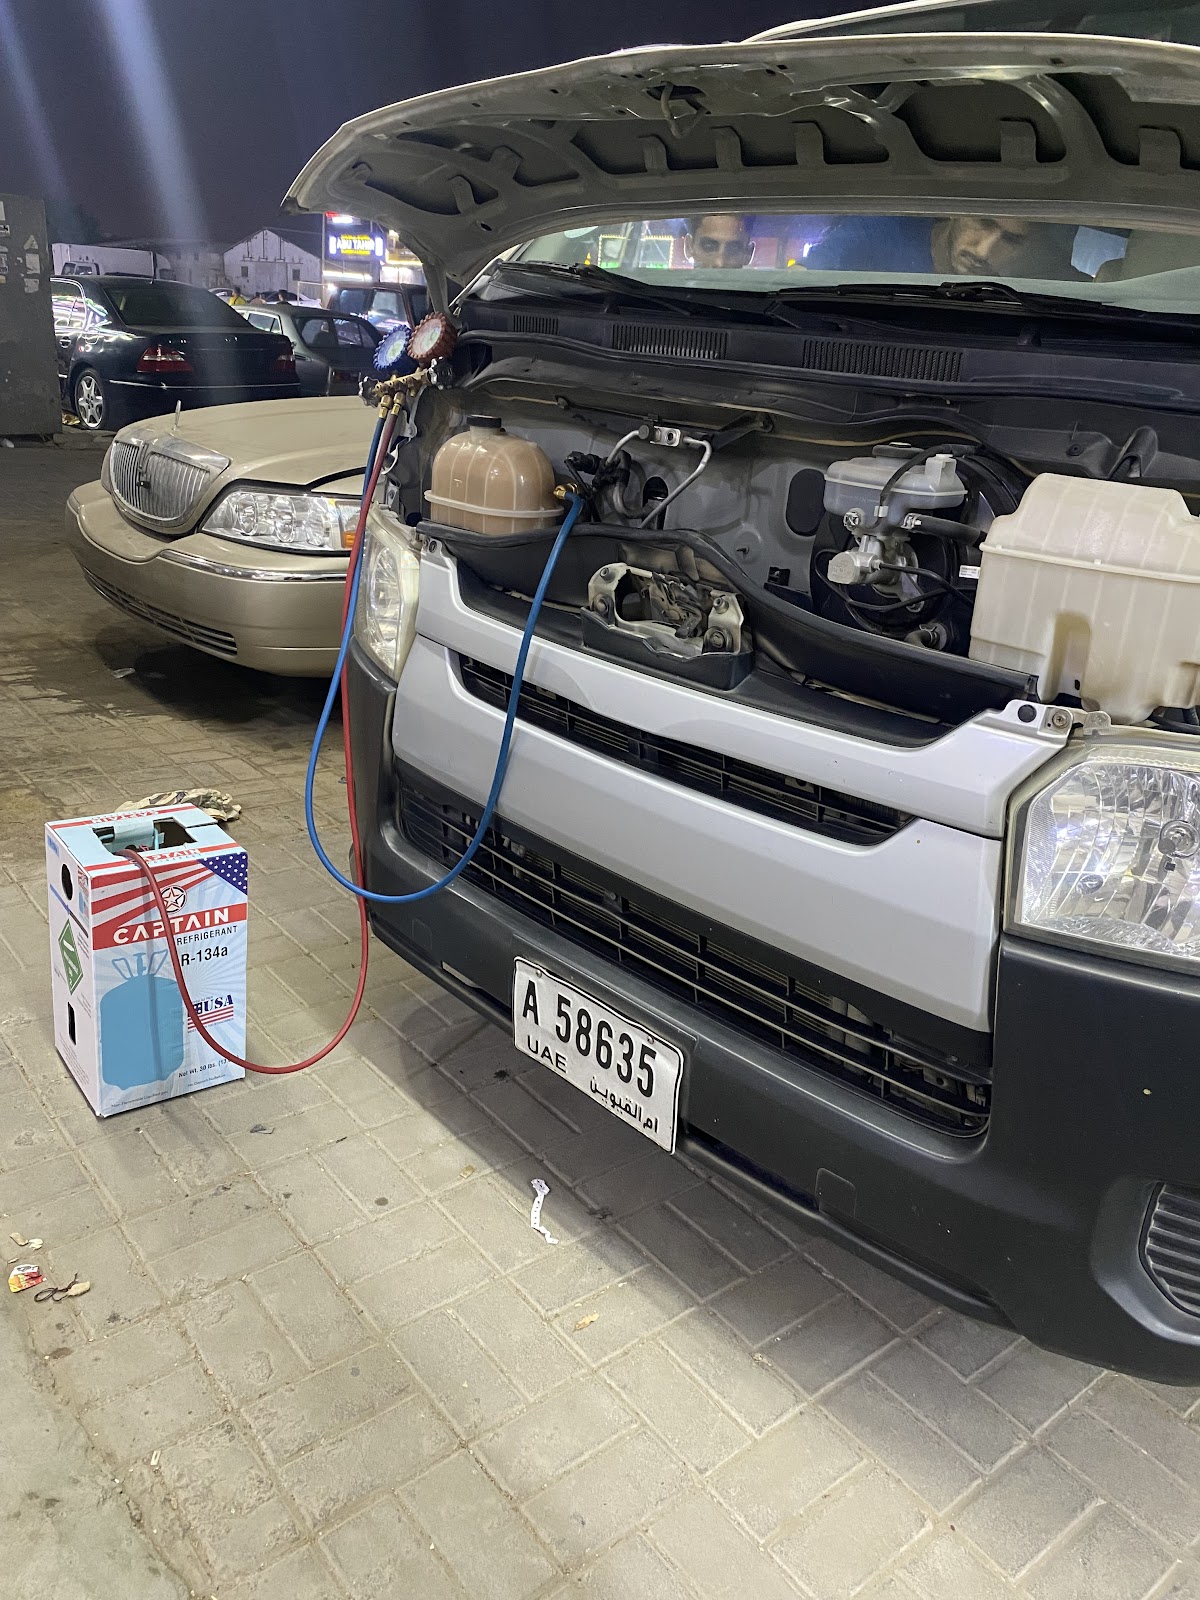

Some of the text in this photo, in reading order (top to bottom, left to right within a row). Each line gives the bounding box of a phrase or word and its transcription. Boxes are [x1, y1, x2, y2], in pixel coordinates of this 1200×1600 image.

[113, 907, 230, 944] CAPTAIN
[176, 925, 239, 946] REFRIGERANT
[181, 945, 229, 967] R-134a
[204, 994, 234, 1015] USA
[522, 979, 657, 1098] A 58635
[526, 1034, 568, 1074] UAE
[589, 1076, 642, 1123] القيوين
